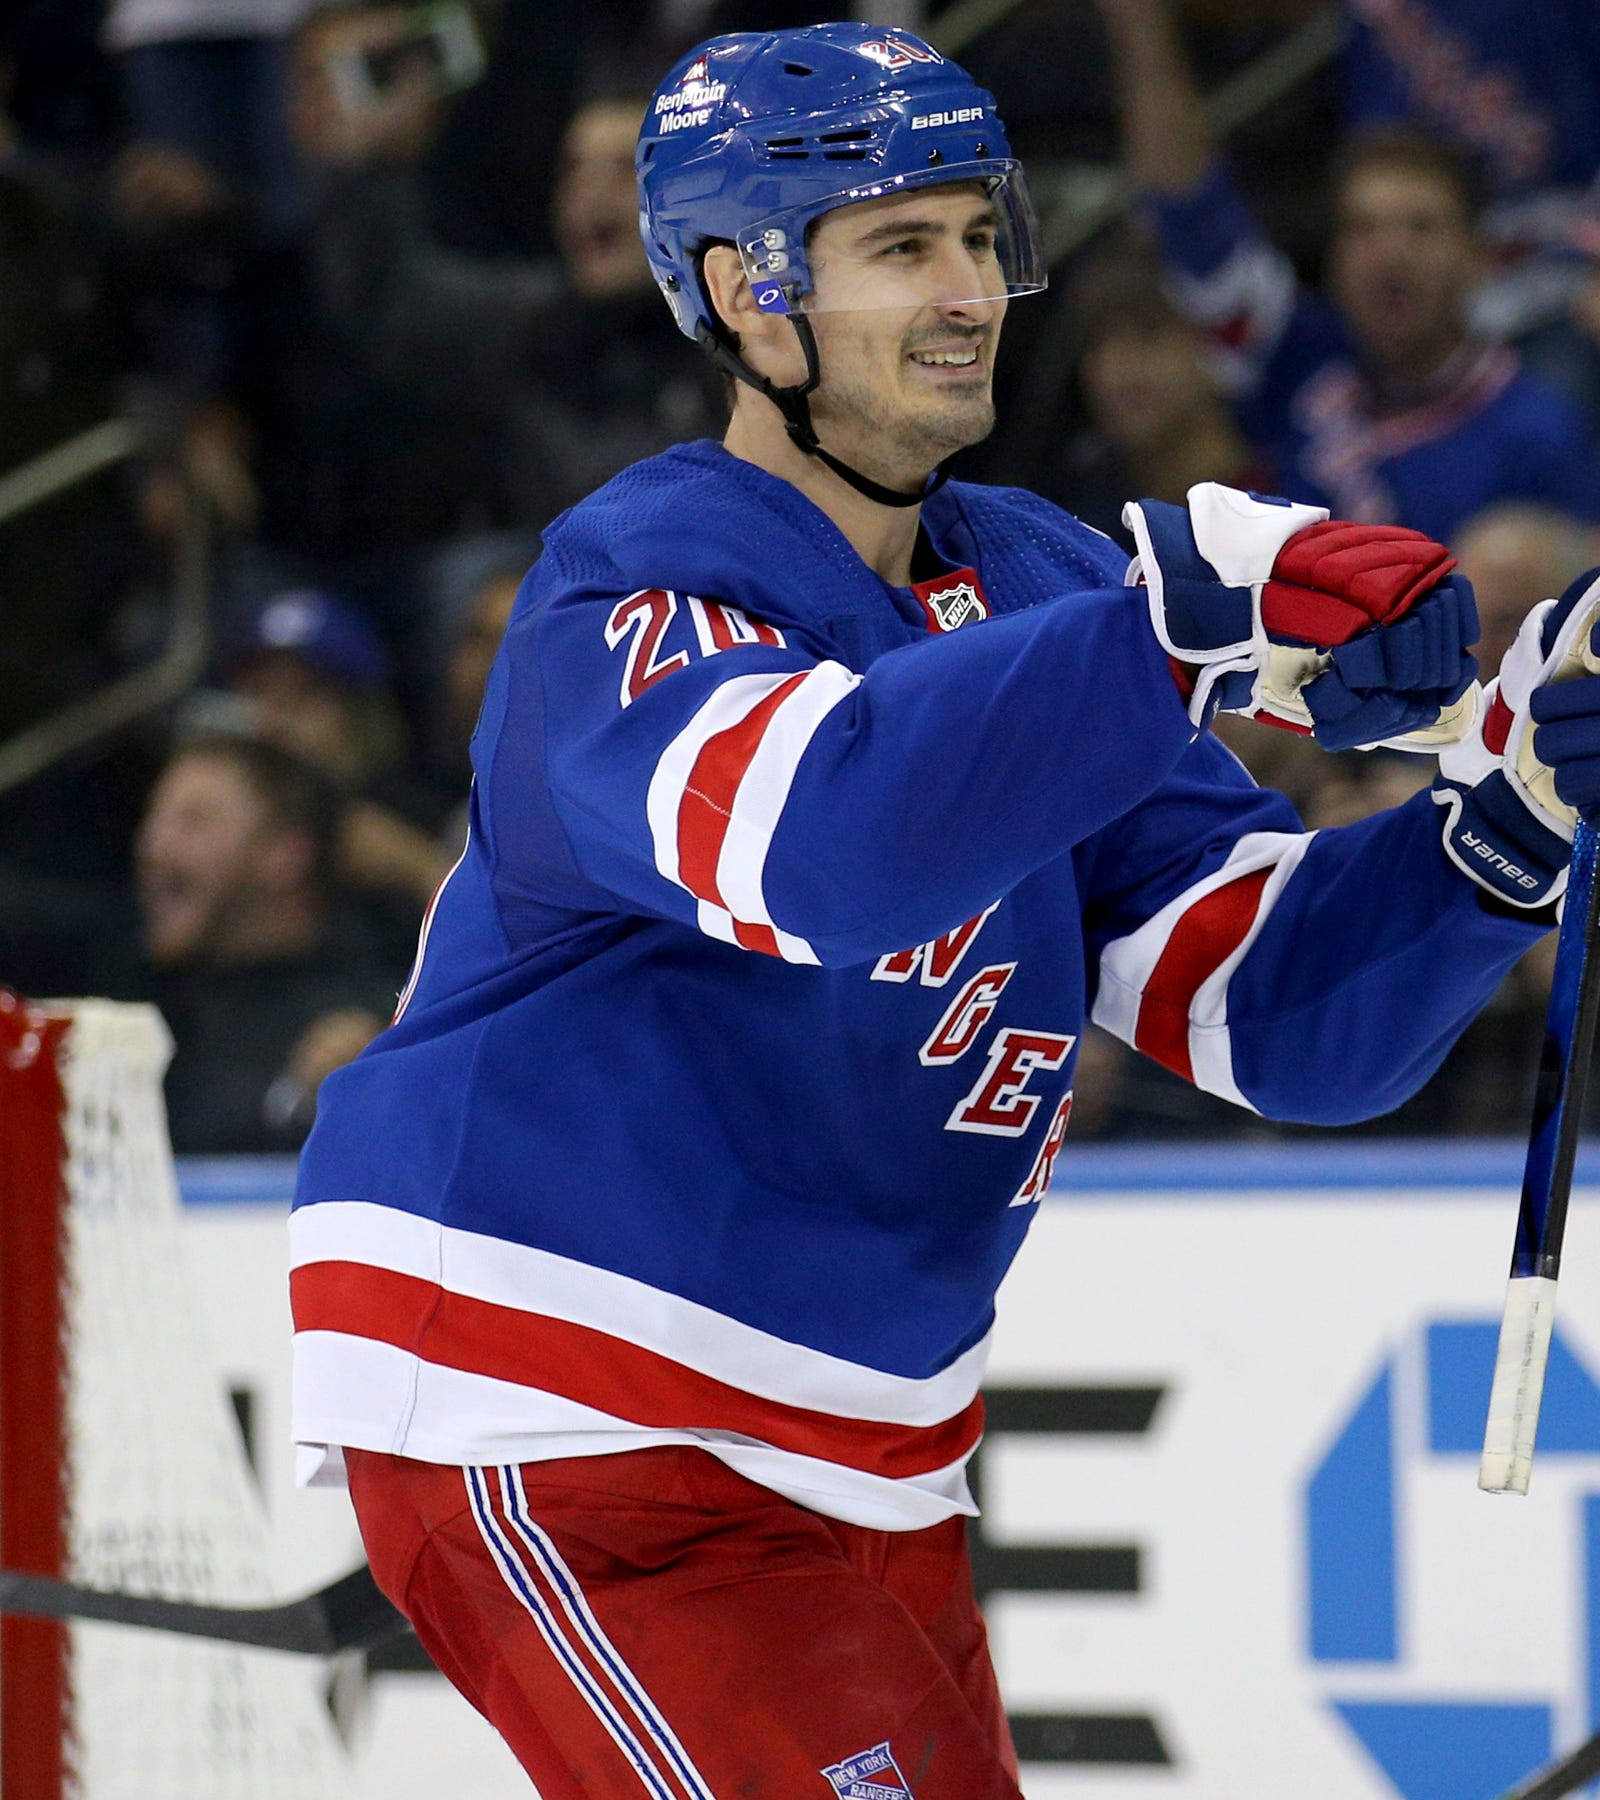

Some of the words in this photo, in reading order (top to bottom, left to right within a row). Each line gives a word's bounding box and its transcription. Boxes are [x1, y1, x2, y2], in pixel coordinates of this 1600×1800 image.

[655, 80, 726, 114] Benjamin
[659, 108, 709, 135] Moore
[911, 106, 984, 130] BAUER
[947, 597, 970, 626] NHL
[1460, 831, 1539, 889] BAUER
[869, 898, 1077, 1208] NGER
[831, 1766, 858, 1786] NEW
[859, 1753, 889, 1772] YORK
